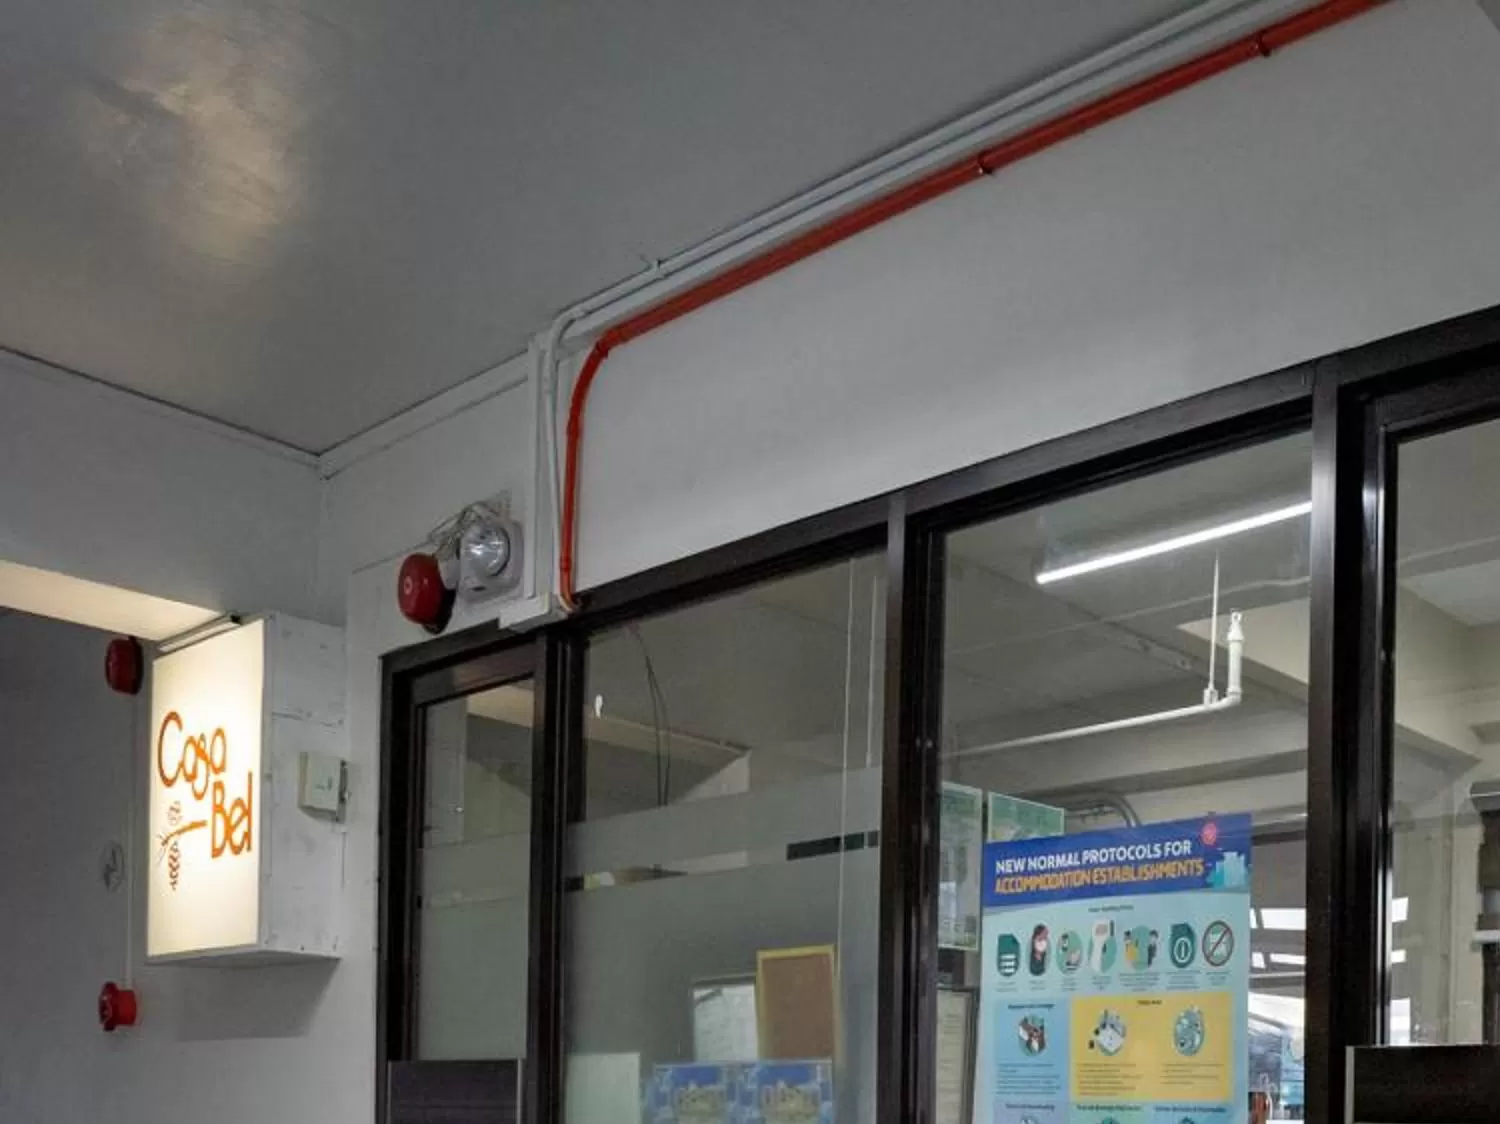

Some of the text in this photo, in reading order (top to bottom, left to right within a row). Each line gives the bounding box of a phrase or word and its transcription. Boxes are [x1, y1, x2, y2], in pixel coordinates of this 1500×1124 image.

[157, 711, 227, 800] Casa
[211, 770, 253, 858] Bel
[995, 858, 1205, 894] ACCOMMODATION ESTABLISHMENTS
[996, 840, 1192, 874] NEW NORMAL PROTOCOLS FOR
